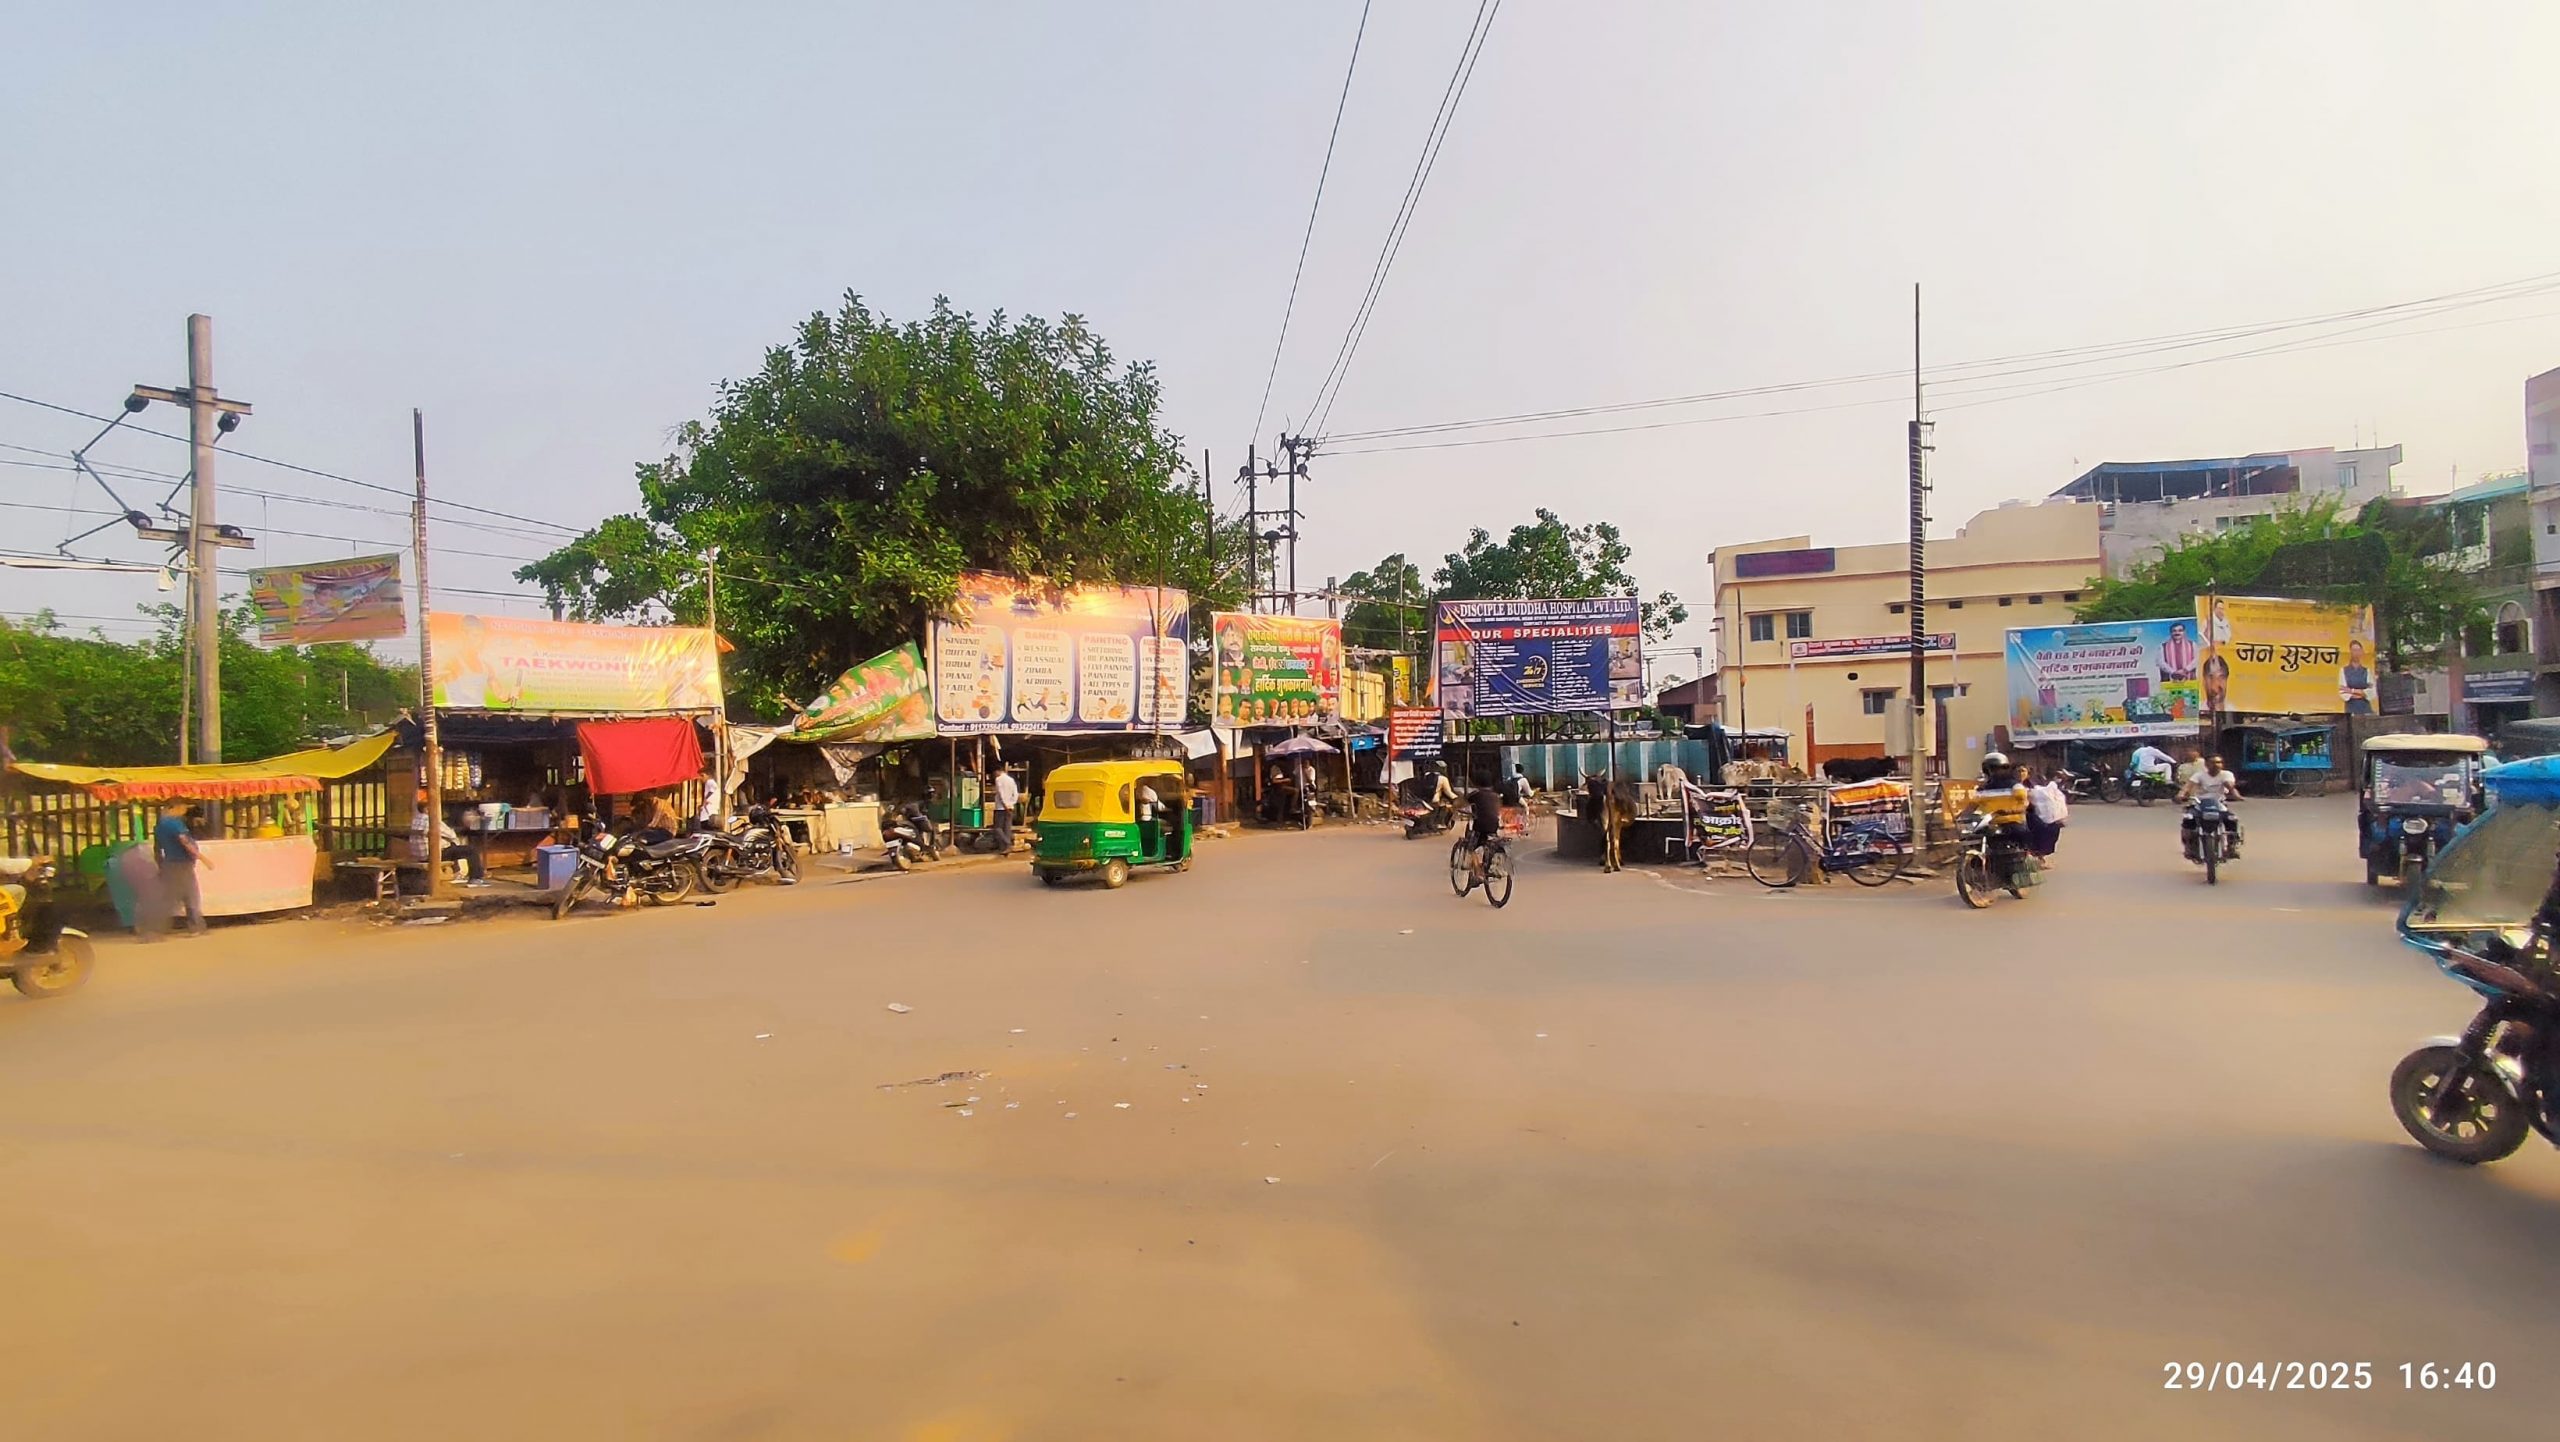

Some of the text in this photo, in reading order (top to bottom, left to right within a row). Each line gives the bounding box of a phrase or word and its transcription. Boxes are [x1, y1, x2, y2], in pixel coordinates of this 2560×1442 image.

[1460, 600, 1633, 617] DISCIPLE BUDDHA HOSPITAL PVT. LTD.
[1471, 625, 1612, 640] OUR SPECIALITIES
[945, 637, 979, 645] SINGING
[945, 649, 978, 657] GUITAR
[2129, 645, 2143, 656] की
[2236, 642, 2340, 673] जन सुराज
[945, 684, 974, 692] TABLA
[938, 723, 966, 731] Contact
